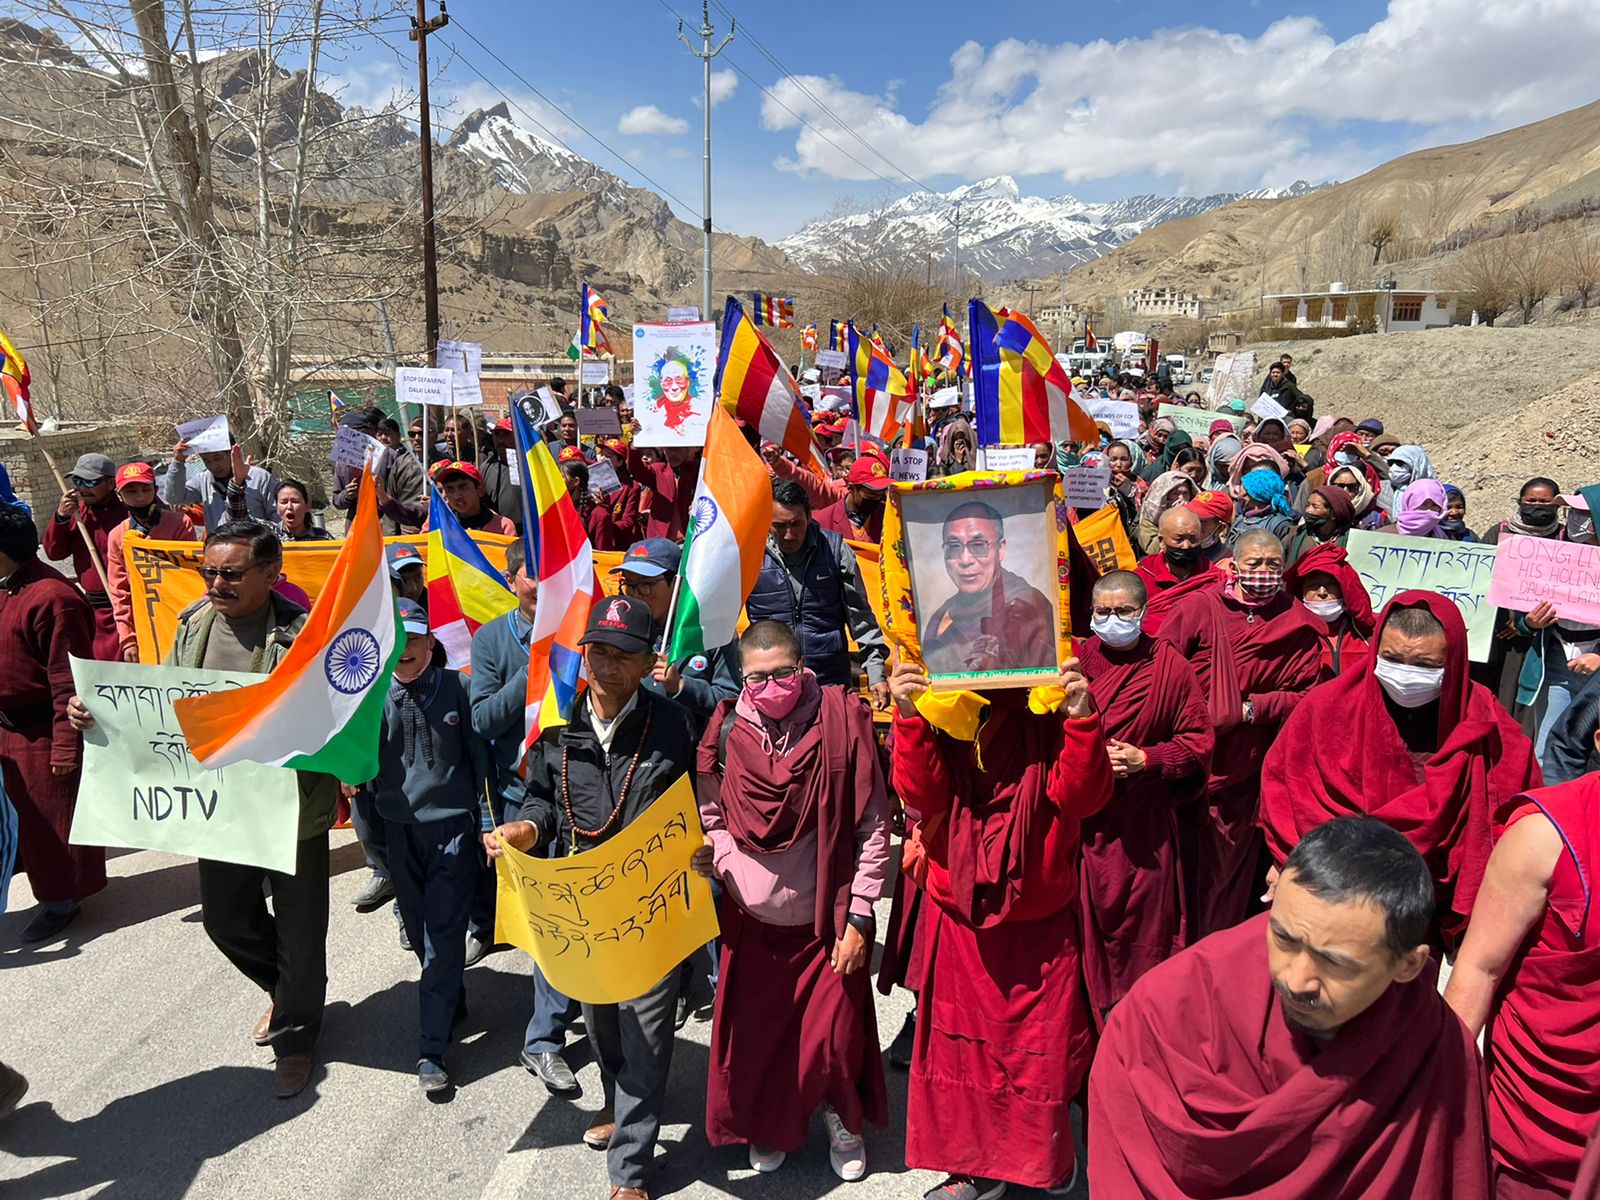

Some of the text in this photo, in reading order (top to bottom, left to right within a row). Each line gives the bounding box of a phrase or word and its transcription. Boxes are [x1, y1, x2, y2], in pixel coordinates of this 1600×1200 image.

[904, 456, 923, 465] STOP
[898, 472, 921, 481] NEWS
[1508, 537, 1572, 564] LONG
[1518, 561, 1543, 579] HIS
[1519, 580, 1559, 599] DALAI
[133, 786, 219, 821] NDTV
